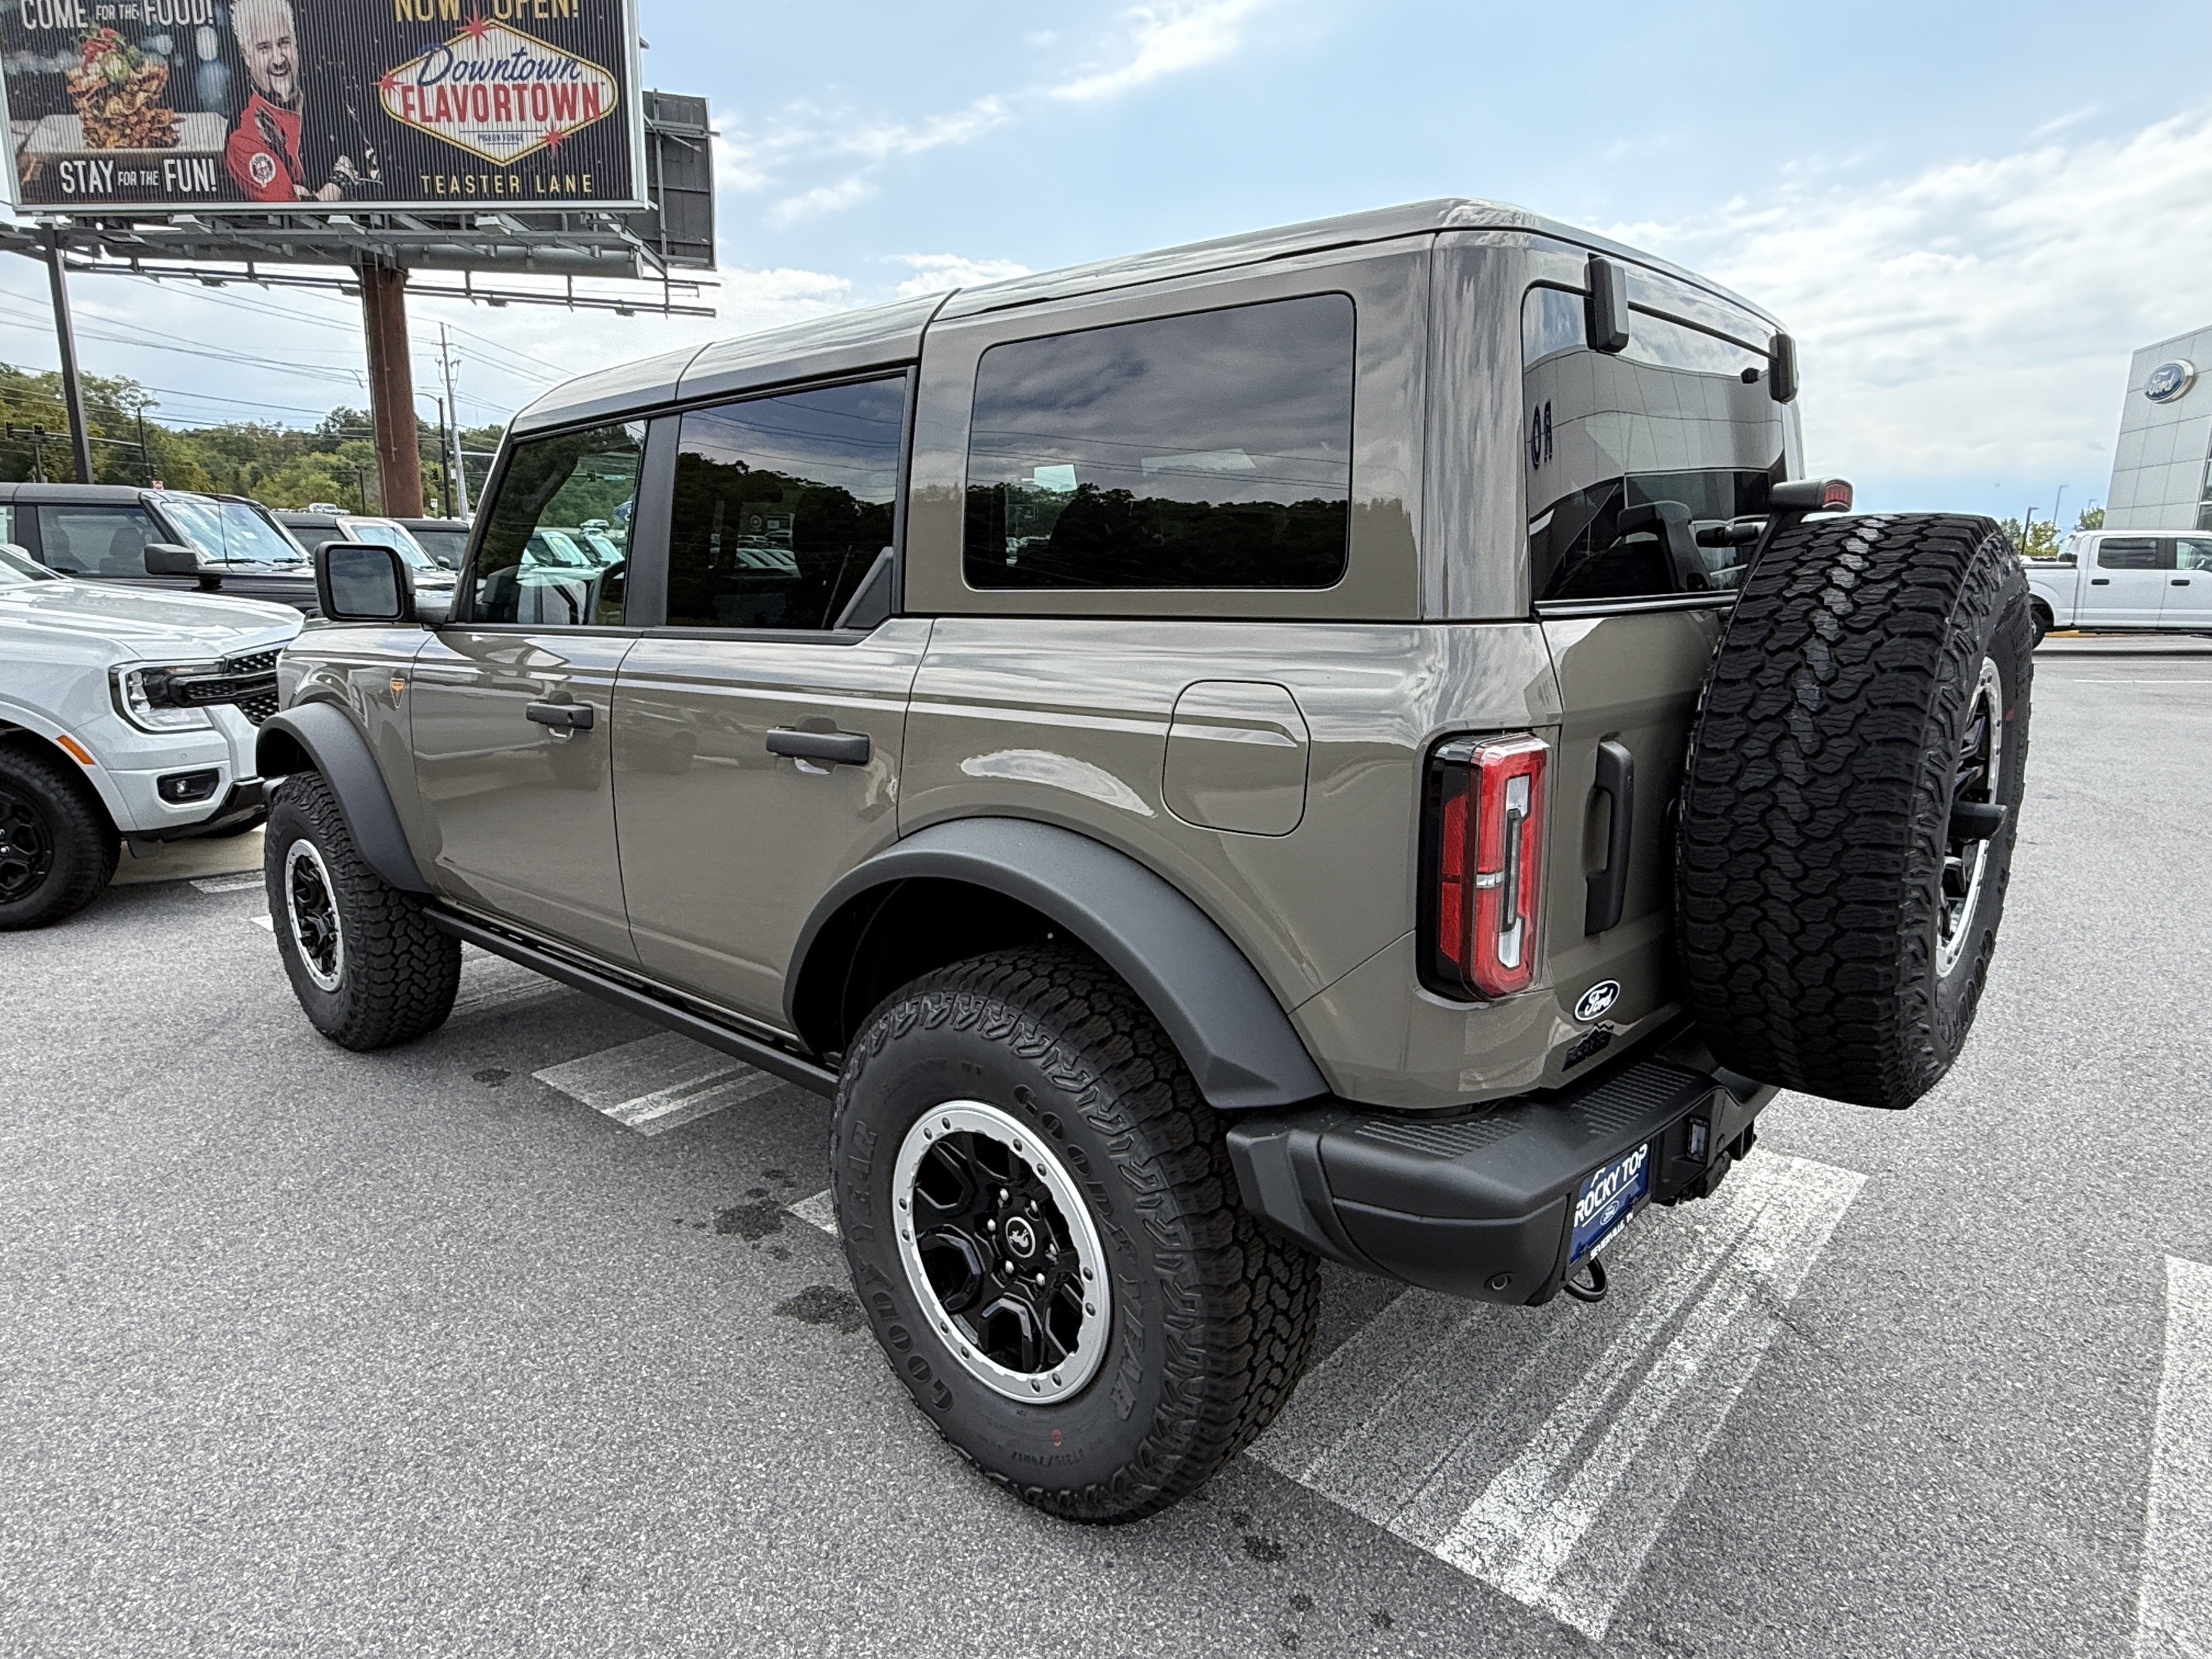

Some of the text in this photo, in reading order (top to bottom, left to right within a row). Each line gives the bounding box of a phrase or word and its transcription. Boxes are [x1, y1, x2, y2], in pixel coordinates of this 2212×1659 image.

[21, 0, 215, 30] COME FOR THE FOOD!
[394, 0, 461, 22] NOW
[417, 42, 581, 87] Downtown
[400, 81, 601, 123] FLAVORTOWN
[477, 133, 524, 142] PIGEON FORGE
[60, 159, 217, 194] STAY FOR THE FUN!
[420, 174, 592, 194] TEASTER LANE
[1584, 986, 1614, 1017] Ford
[1573, 1143, 1648, 1228] ROCKY TOP
